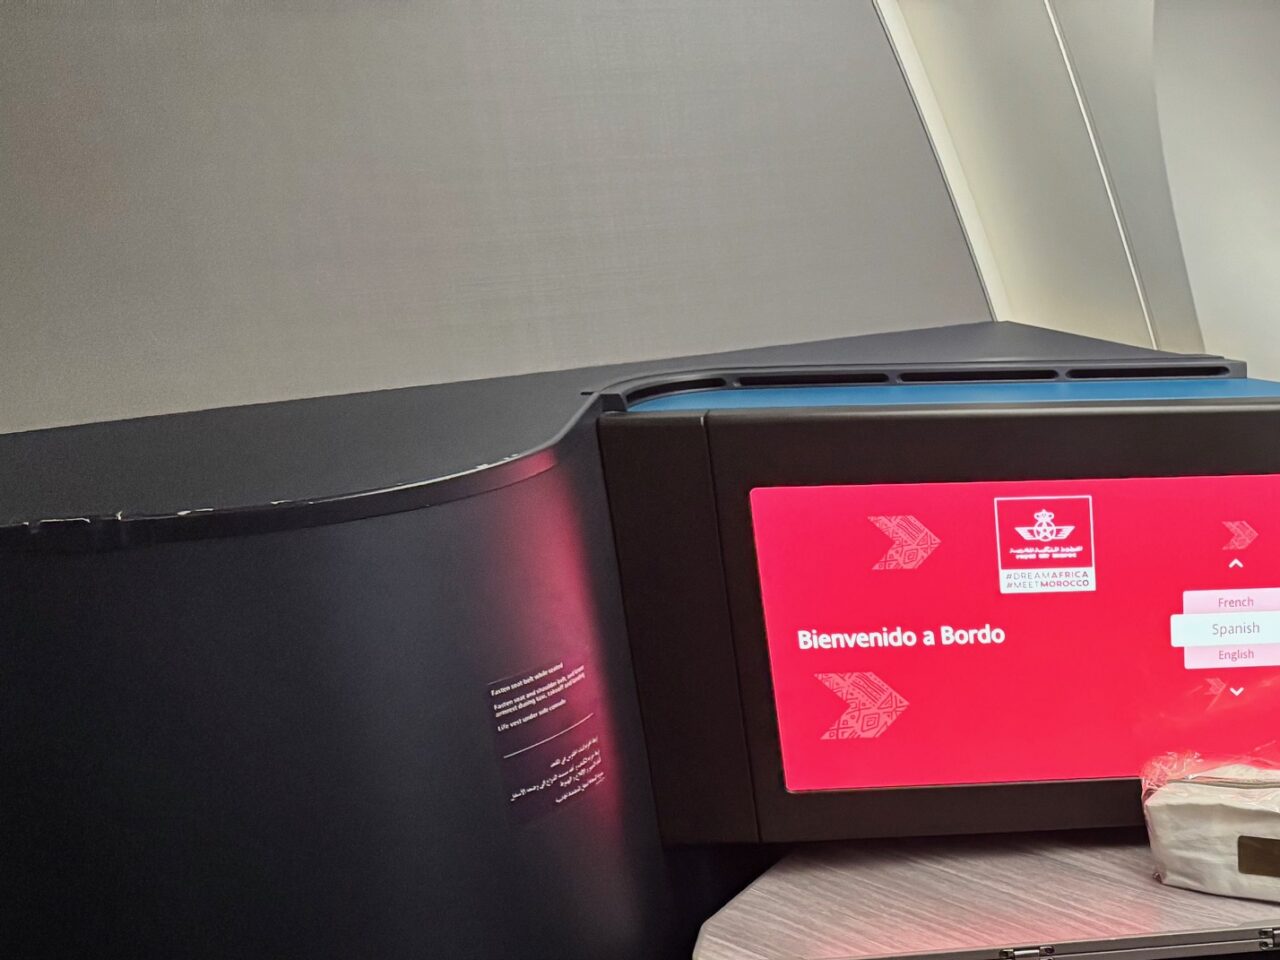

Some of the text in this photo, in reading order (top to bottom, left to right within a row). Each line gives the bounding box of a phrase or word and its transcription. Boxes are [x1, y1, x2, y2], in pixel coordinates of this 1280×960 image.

[1006, 571, 1089, 580] #DREAMAFRICA
[1006, 580, 1090, 588] #MEETMOROCCO
[1218, 596, 1254, 608] French
[1212, 621, 1260, 637] Spanish
[797, 623, 1006, 650] Bienvenido a Bordo
[1218, 649, 1255, 662] English
